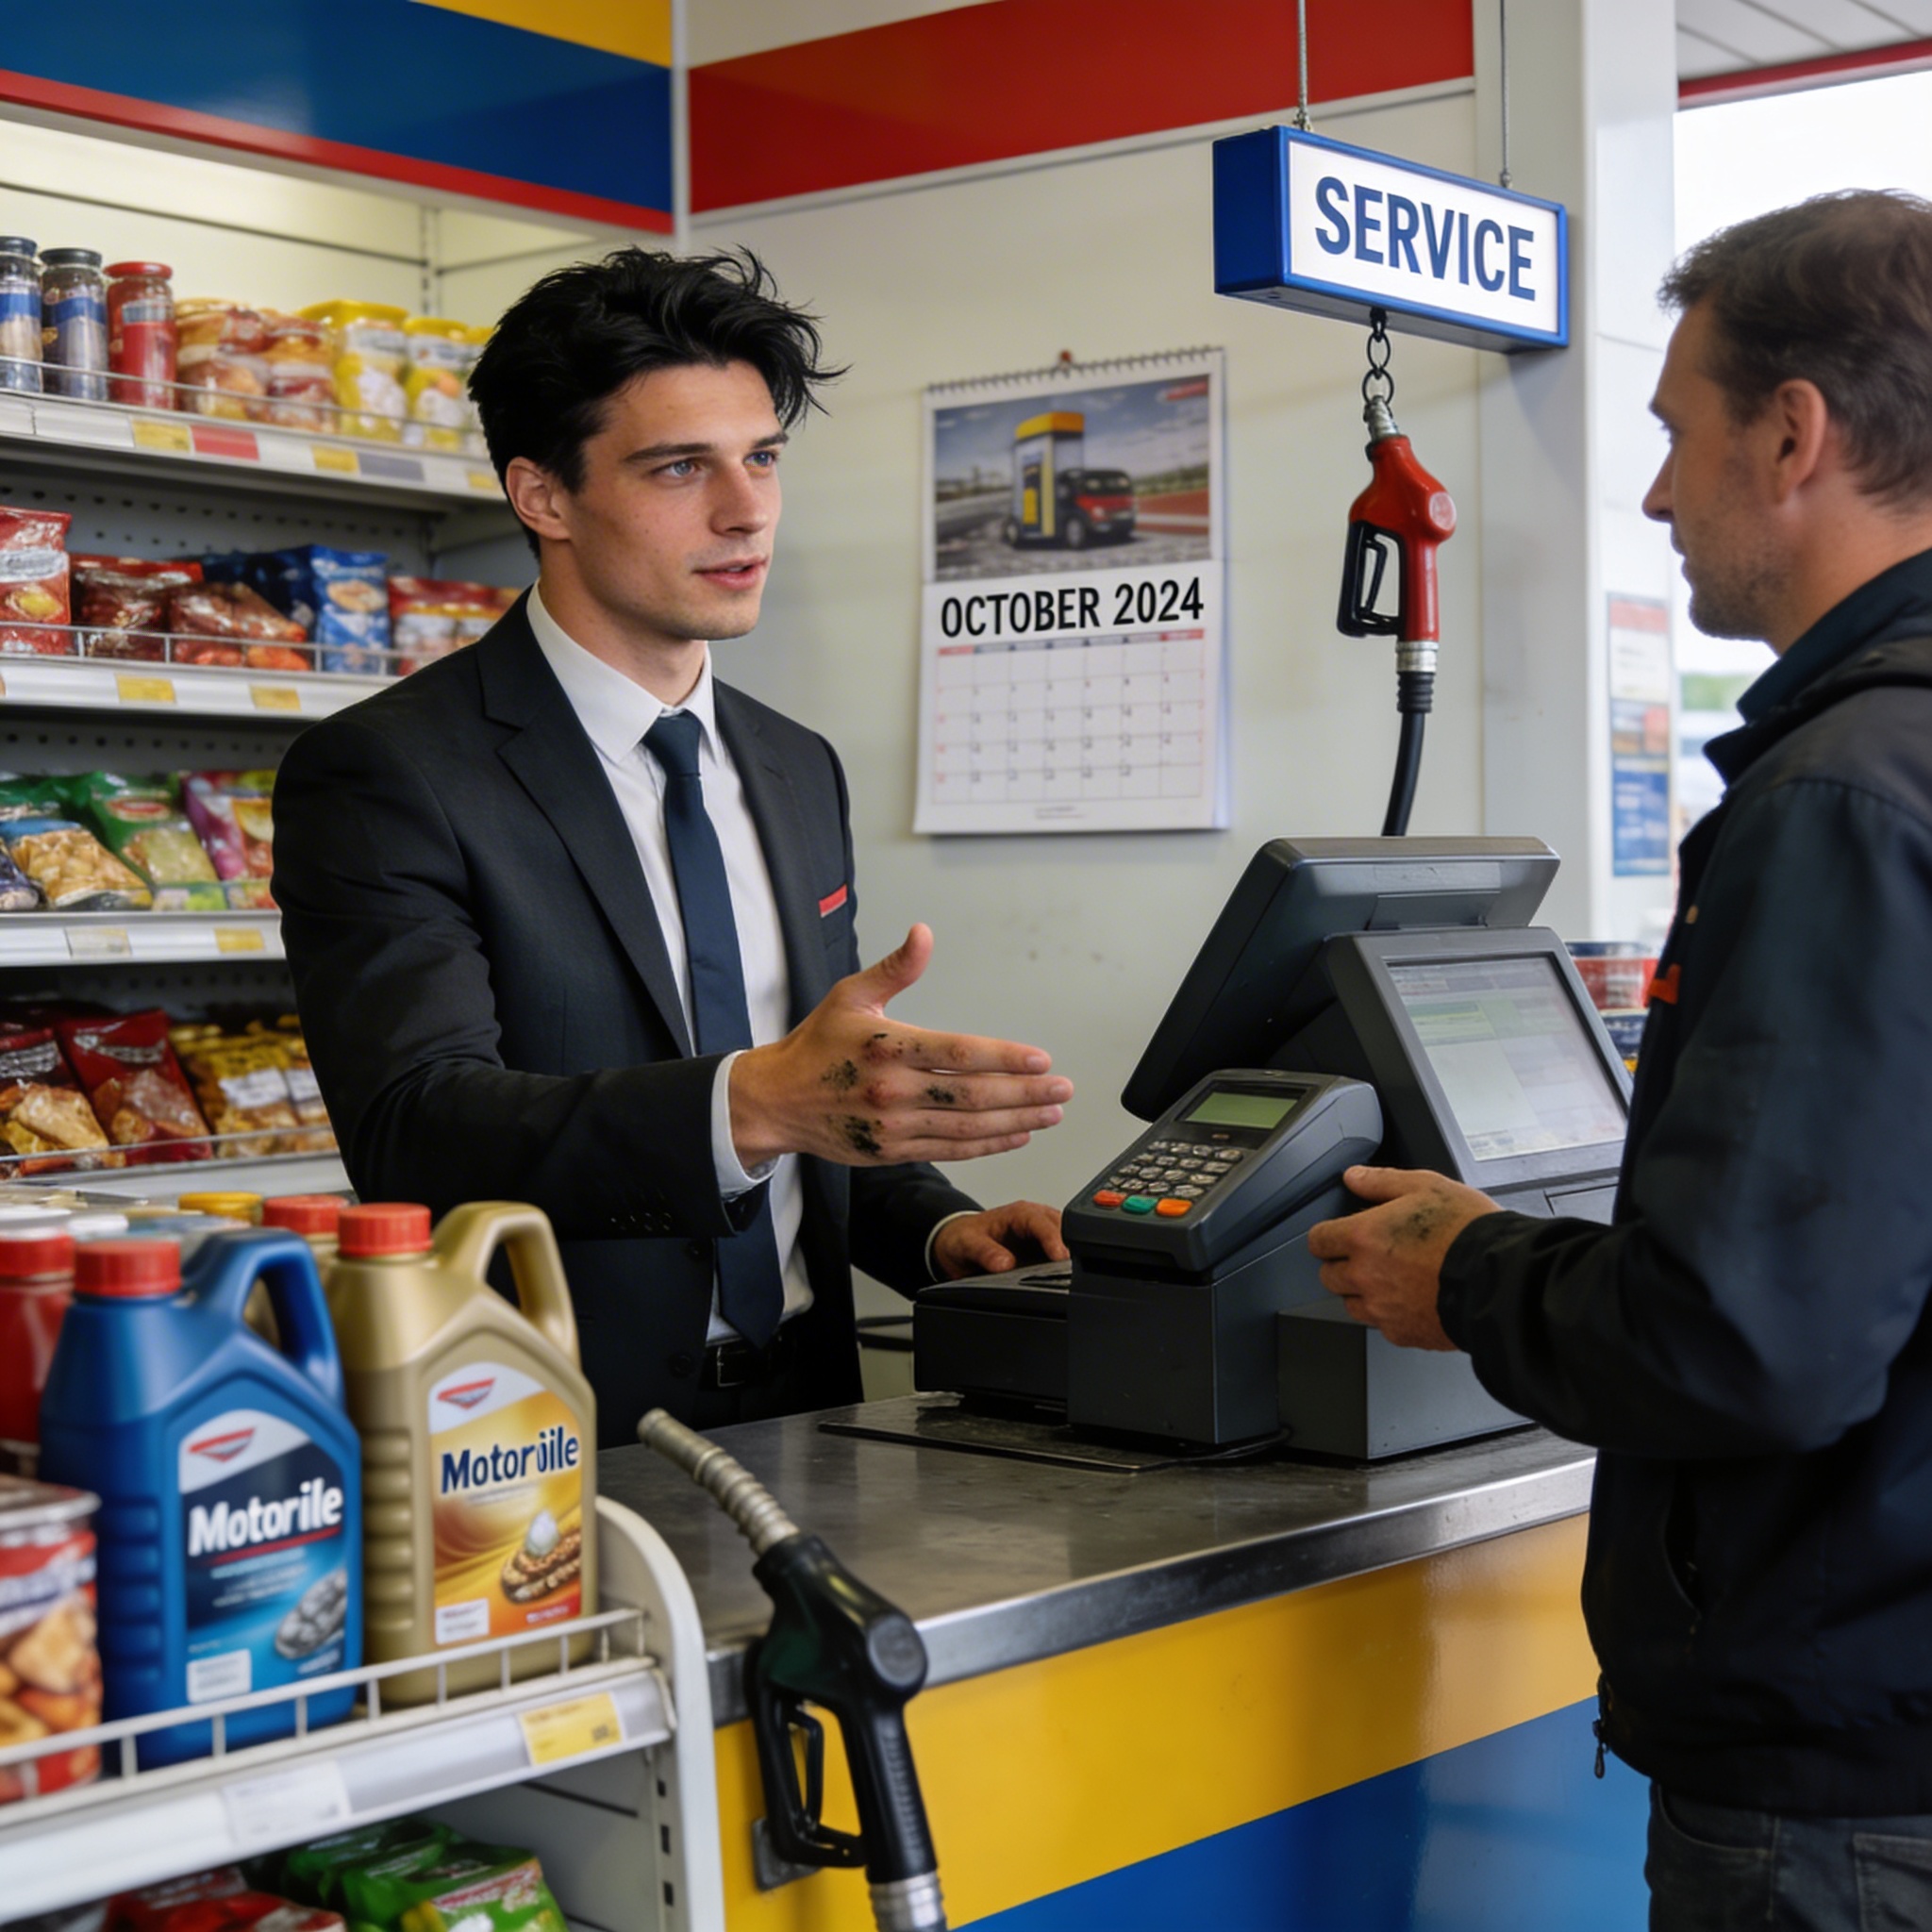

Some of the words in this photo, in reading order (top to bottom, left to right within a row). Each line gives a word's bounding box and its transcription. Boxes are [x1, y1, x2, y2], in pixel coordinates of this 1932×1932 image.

[1315, 176, 1536, 301] SERVICE
[941, 587, 1101, 638] OCTOBER
[1113, 576, 1205, 625] 2024
[189, 1477, 343, 1557] Motorile
